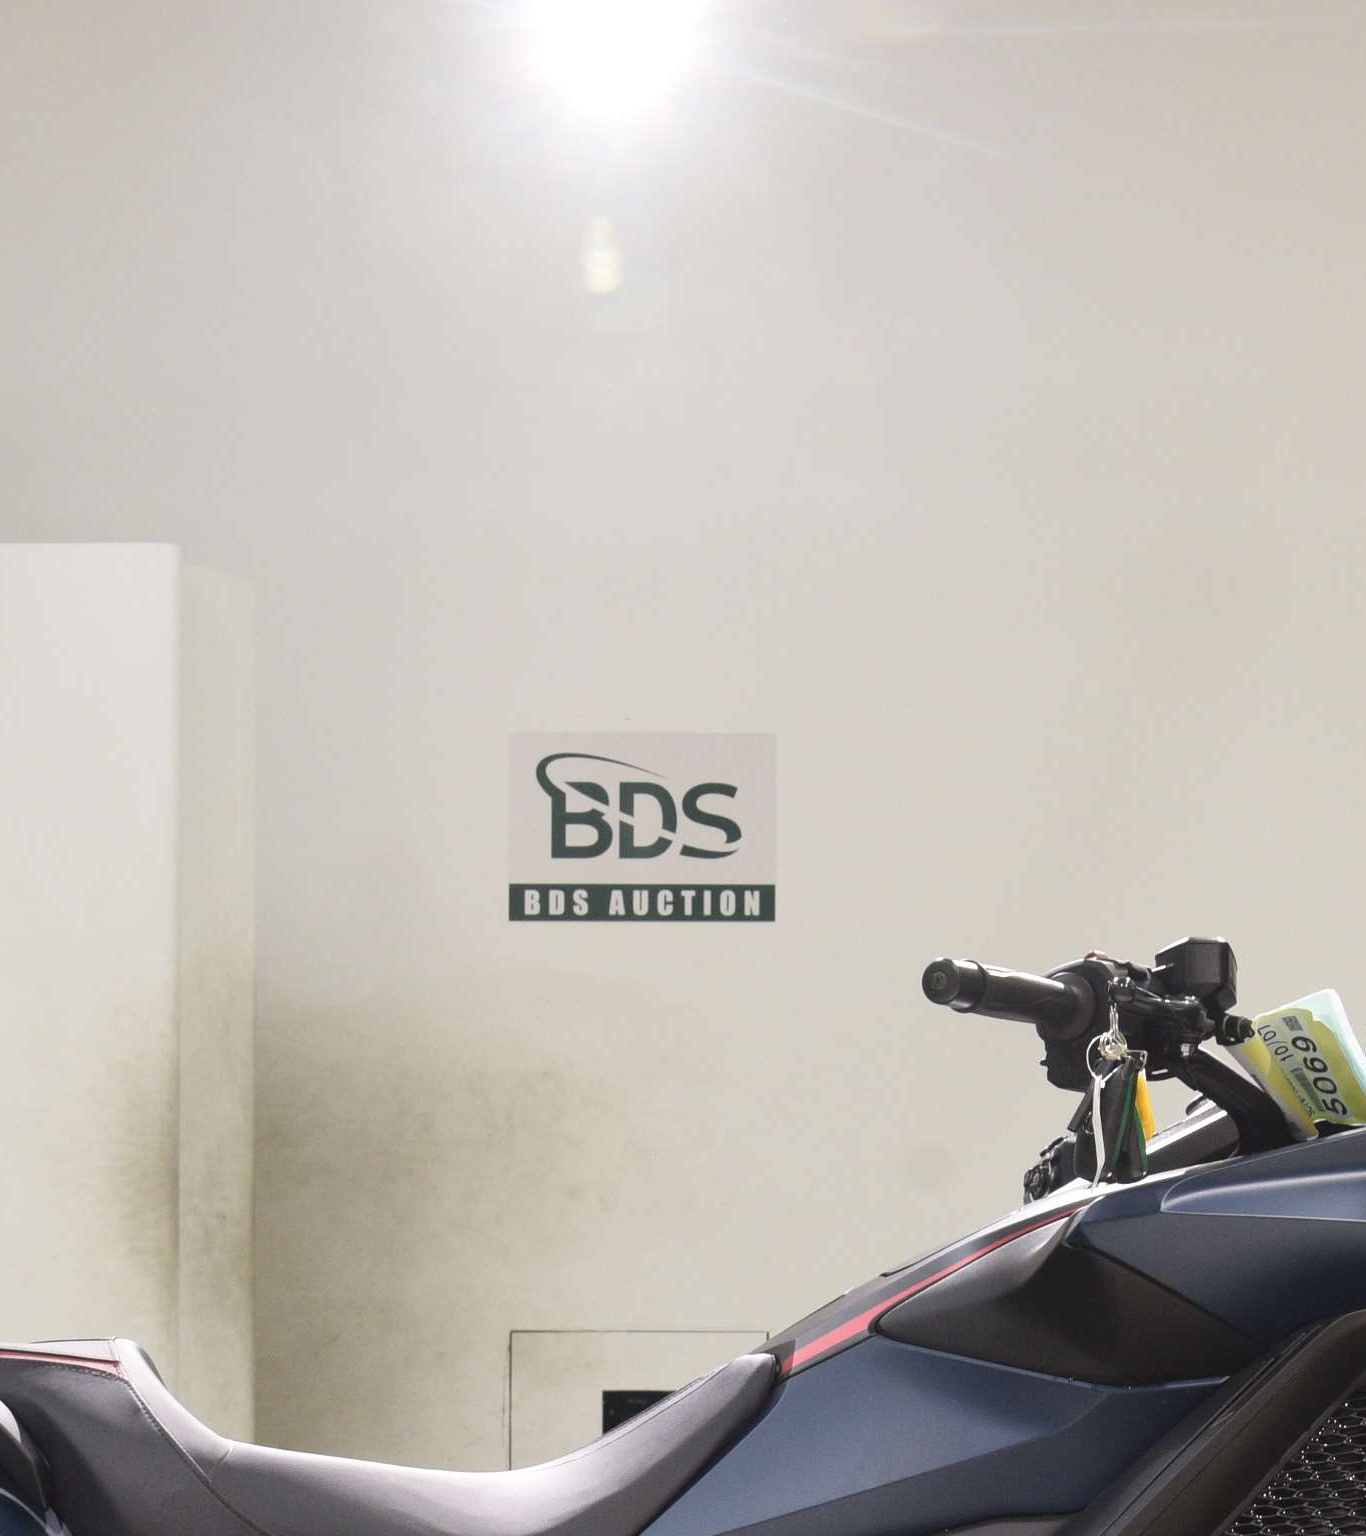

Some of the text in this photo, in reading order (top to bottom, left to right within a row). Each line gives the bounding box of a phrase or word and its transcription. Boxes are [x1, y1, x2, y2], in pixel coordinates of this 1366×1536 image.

[536, 753, 742, 859] BDS
[524, 889, 761, 916] BDS AUCTION
[1291, 1035, 1348, 1117] 5069
